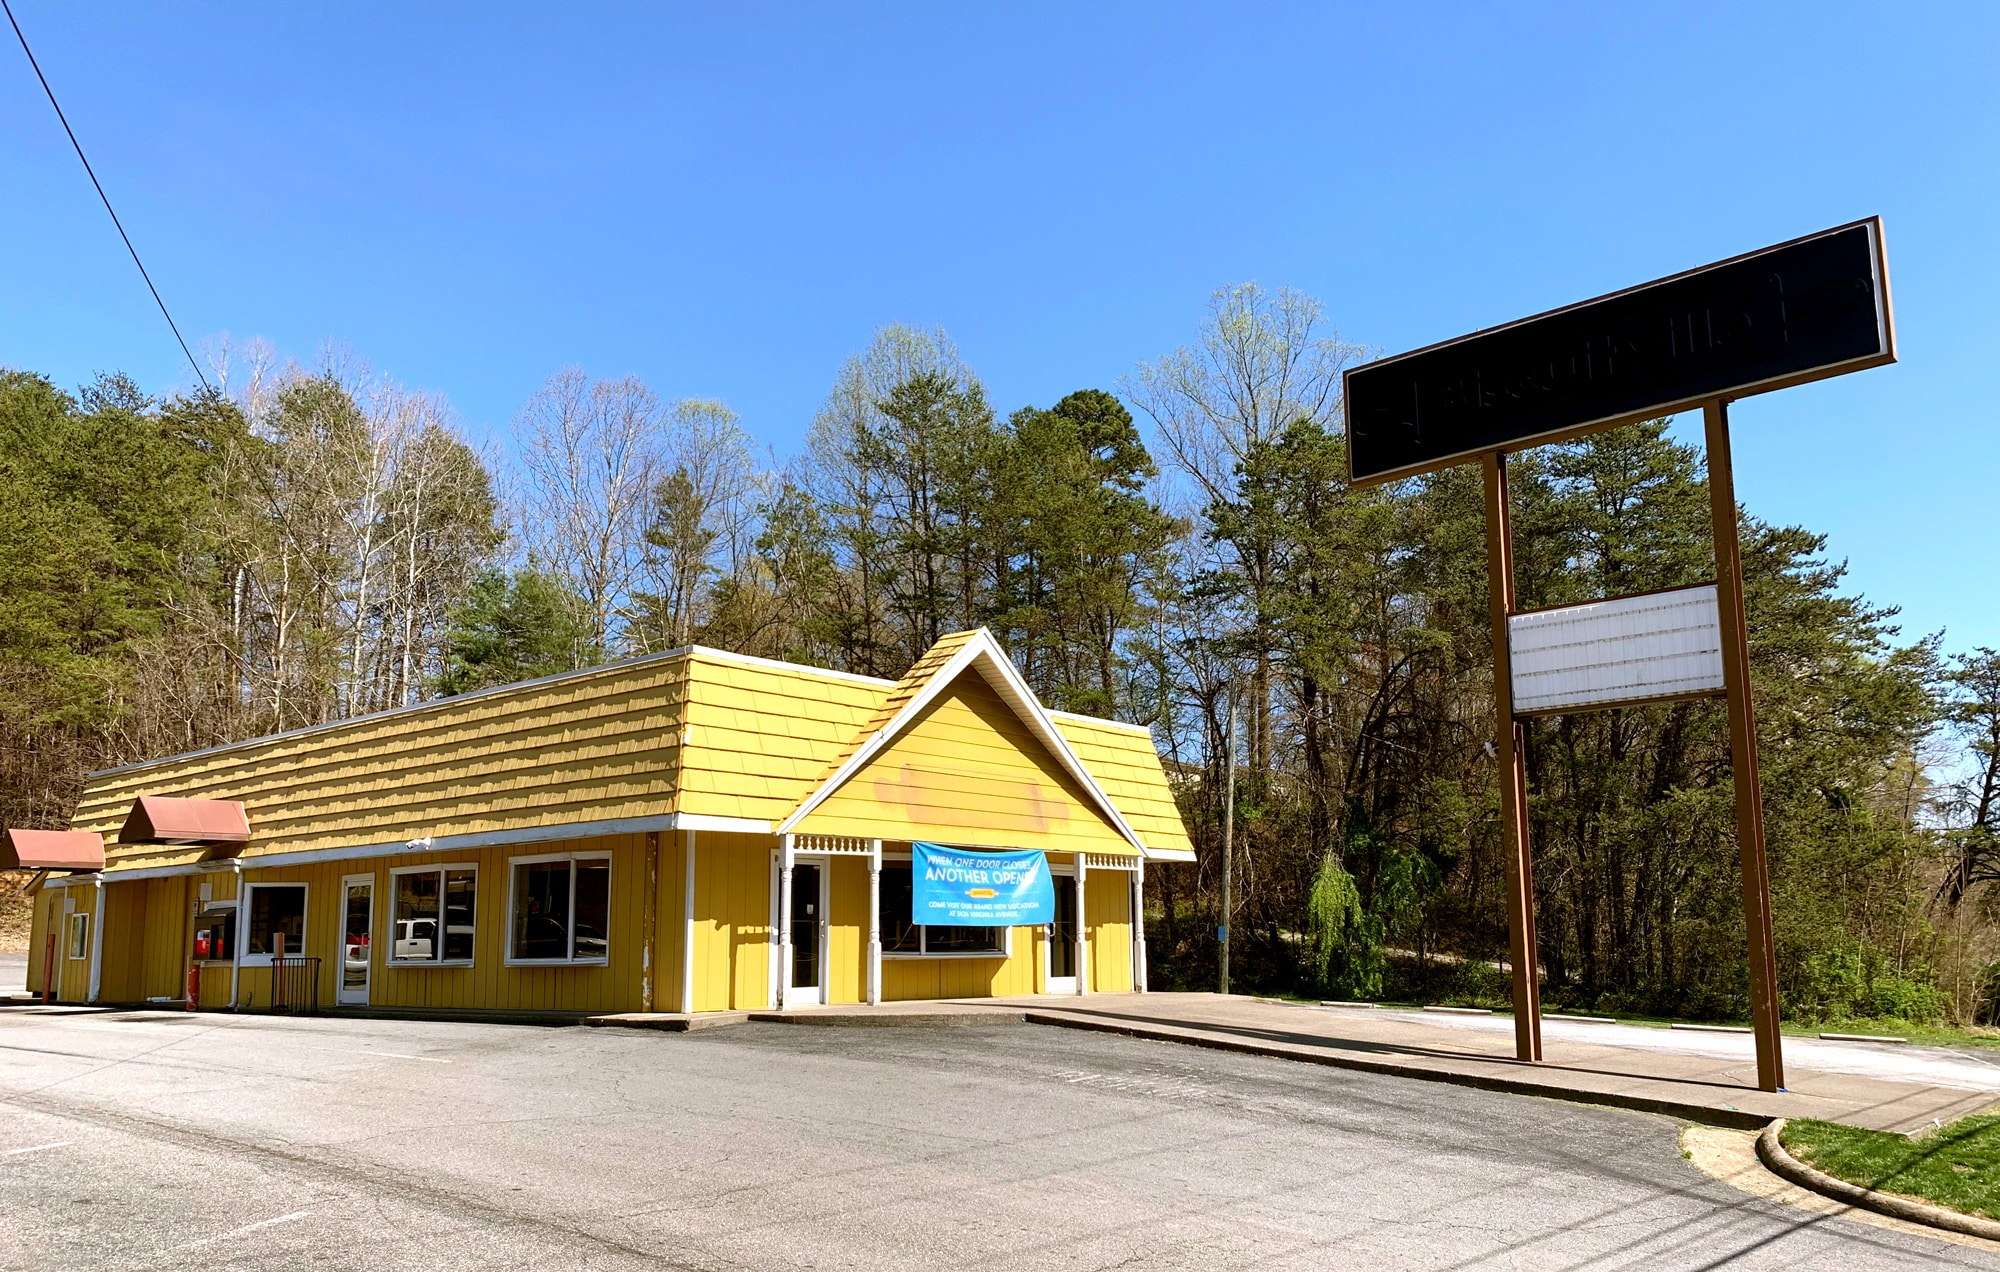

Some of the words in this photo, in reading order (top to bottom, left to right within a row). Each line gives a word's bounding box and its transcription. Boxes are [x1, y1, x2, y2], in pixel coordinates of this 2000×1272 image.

[927, 855, 952, 866] WHEN
[955, 858, 974, 868] ONE
[976, 859, 1000, 870] DOOR
[925, 867, 990, 884] ANOTHER
[928, 901, 946, 909] COME
[1008, 902, 1039, 910] LOCATION
